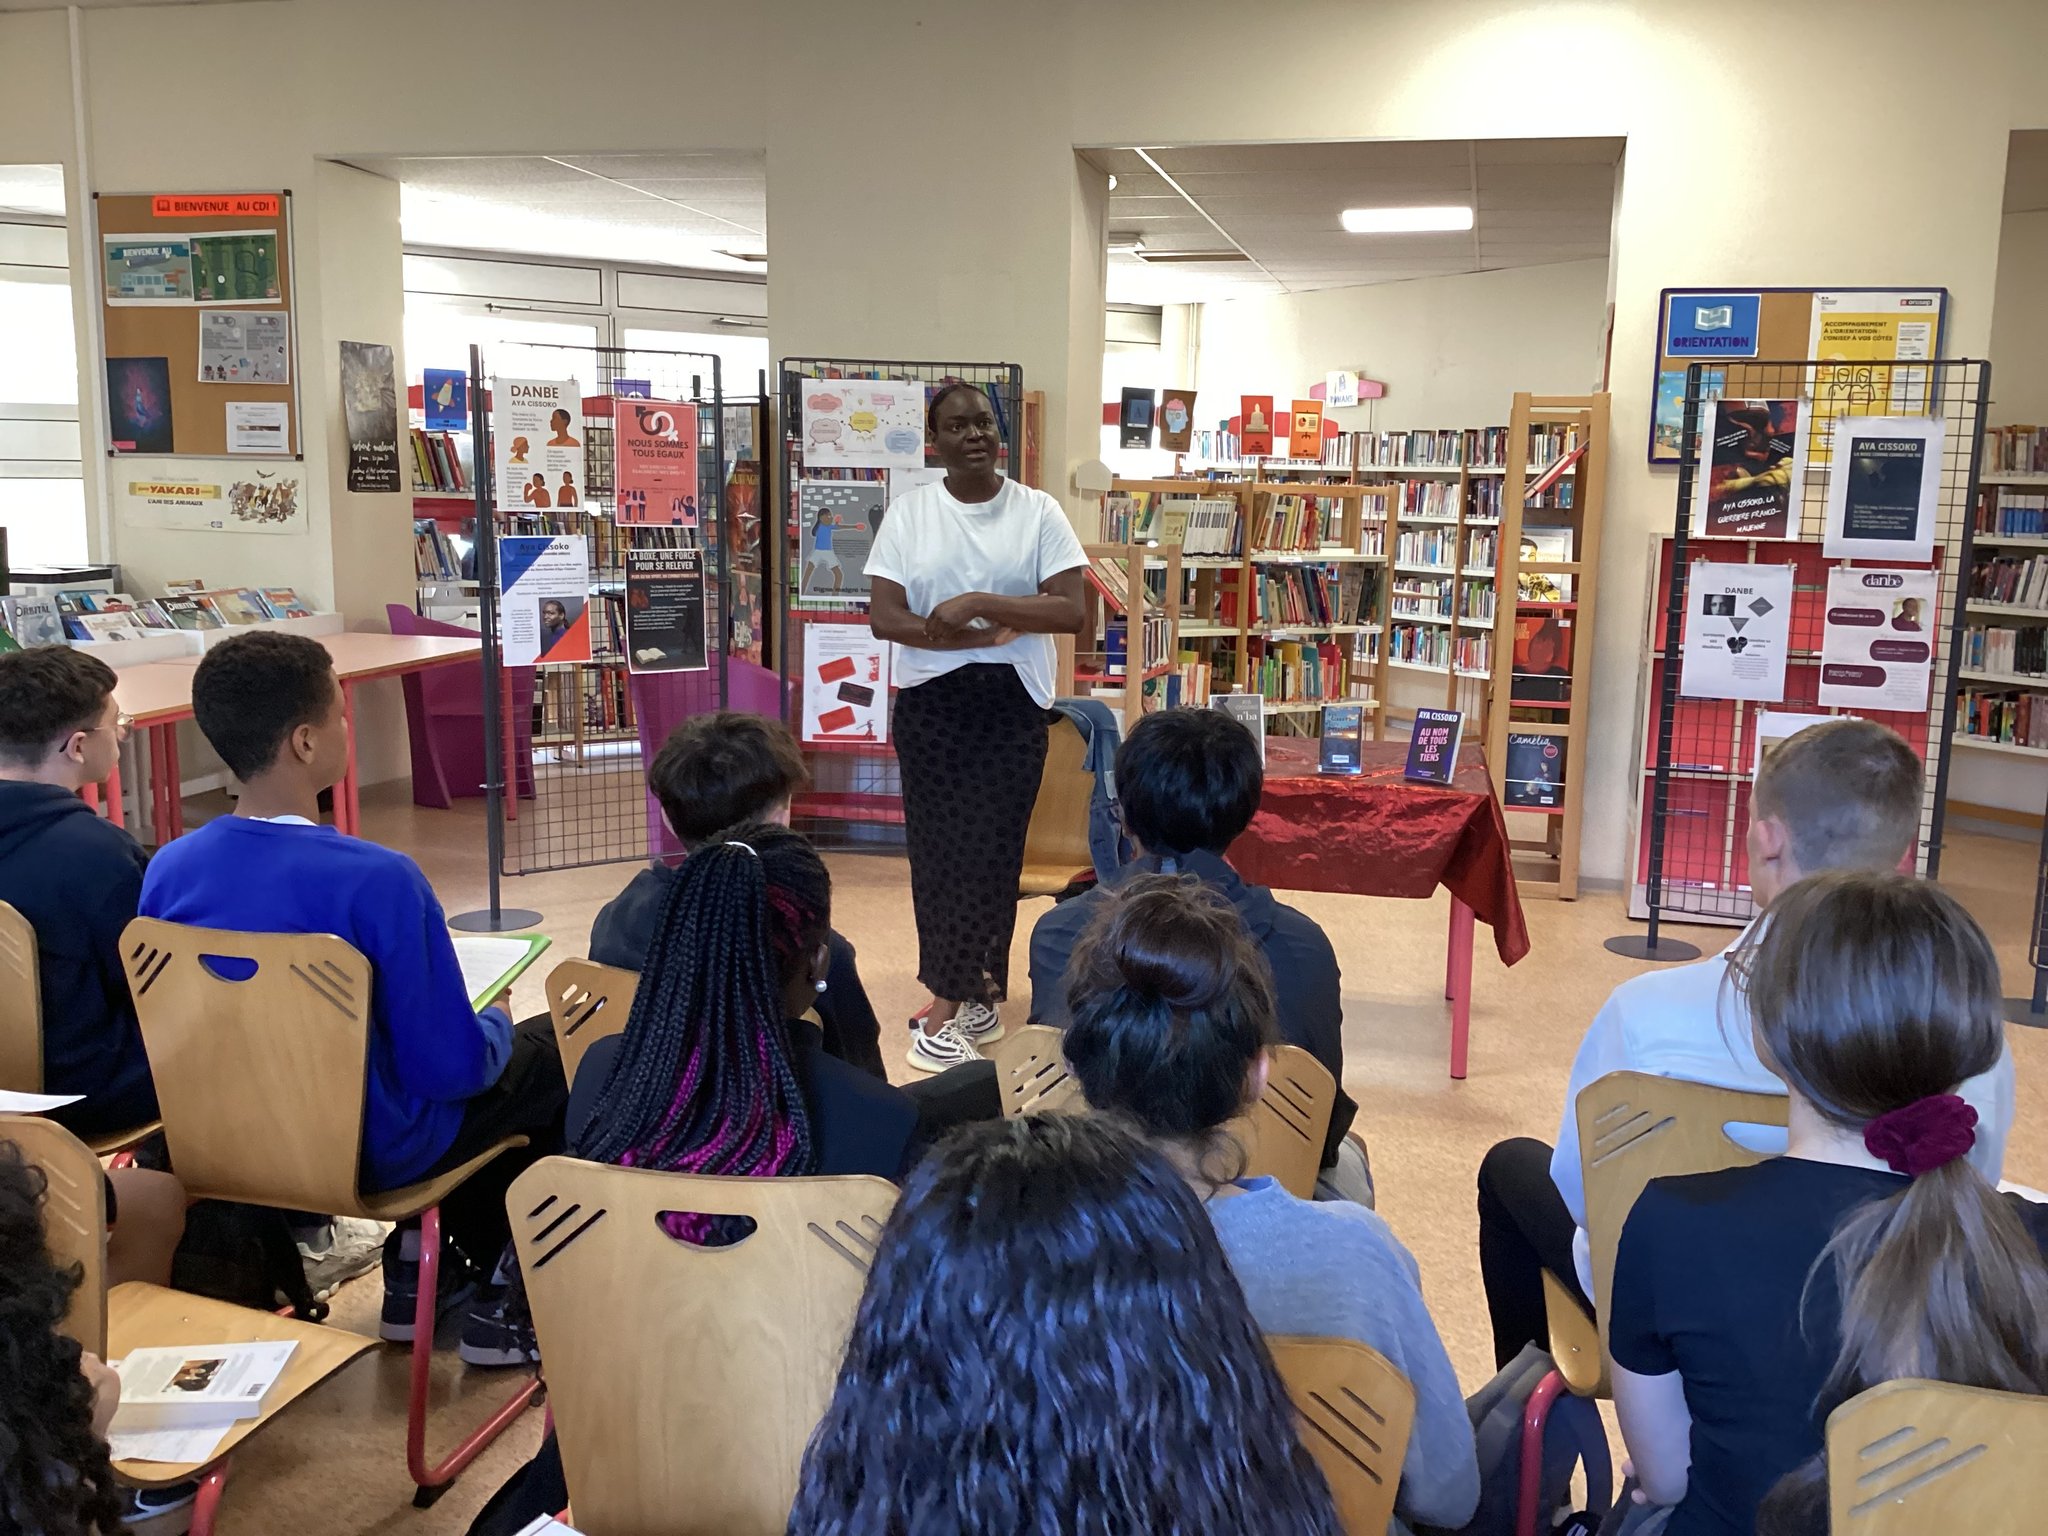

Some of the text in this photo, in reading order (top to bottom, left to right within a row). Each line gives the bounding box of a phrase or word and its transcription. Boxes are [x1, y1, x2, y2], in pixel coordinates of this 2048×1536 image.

[175, 201, 229, 212] BIENVENUE
[236, 201, 250, 211] AU
[252, 201, 270, 211] CDI
[1673, 336, 1749, 348] ORIENTATION
[527, 400, 557, 408] CISSOKO
[627, 439, 689, 449] NOUS SOMMES
[1859, 442, 1918, 451] AYA CISSOKO
[632, 449, 655, 458] TOUS
[150, 485, 200, 496] YAKARI
[1722, 502, 1736, 512] AYA
[1766, 495, 1775, 503] LA
[520, 542, 570, 553] Aya Cissoko
[628, 551, 638, 561] LA
[660, 551, 674, 560] UNE
[674, 551, 696, 560] FORCE
[635, 561, 694, 571] POUR SE RELEVER
[14, 605, 50, 617] ORBITAL
[1236, 710, 1258, 721] n'ba
[1418, 711, 1458, 723] AYA CISSOKO
[1420, 727, 1449, 736] AU NOM
[1418, 736, 1448, 745] DE TOUS
[1425, 744, 1438, 753] LES
[1420, 753, 1440, 762] TIENS
